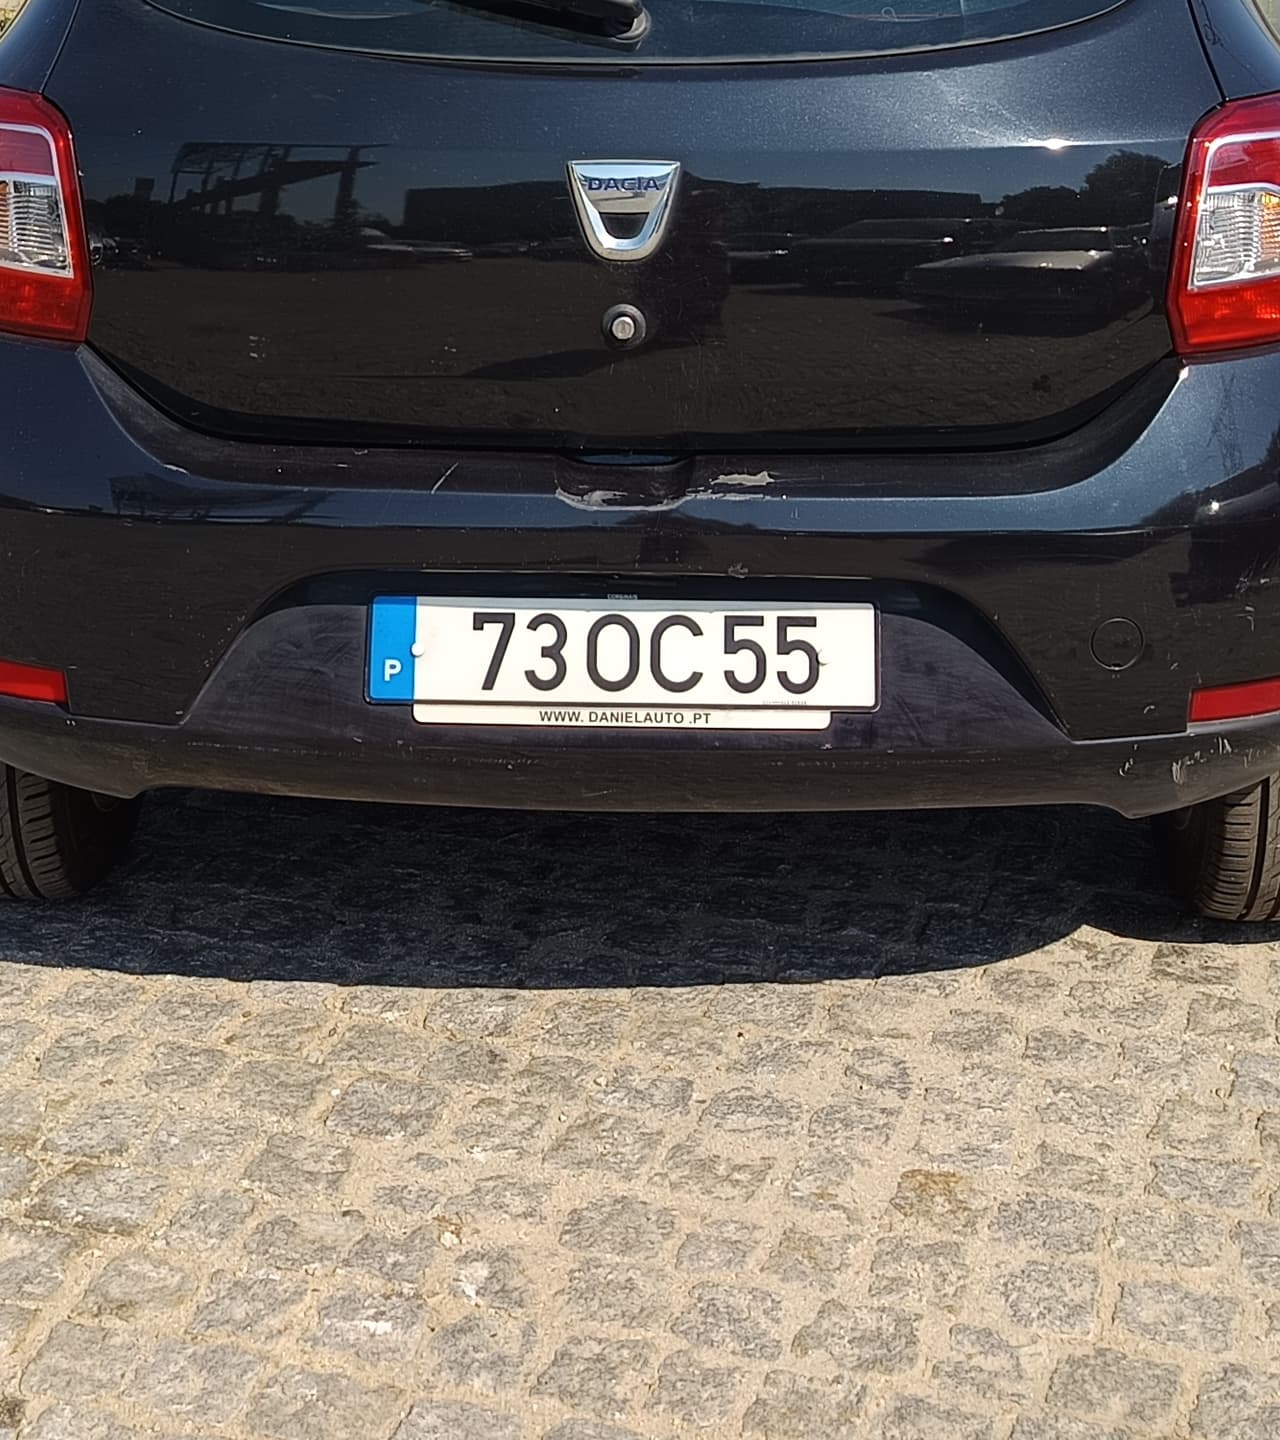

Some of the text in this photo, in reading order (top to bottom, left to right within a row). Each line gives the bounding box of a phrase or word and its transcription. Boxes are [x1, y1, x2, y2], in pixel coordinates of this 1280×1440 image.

[588, 176, 661, 192] DACIA
[384, 658, 402, 682] P
[588, 711, 685, 724] DANIELAUTO
